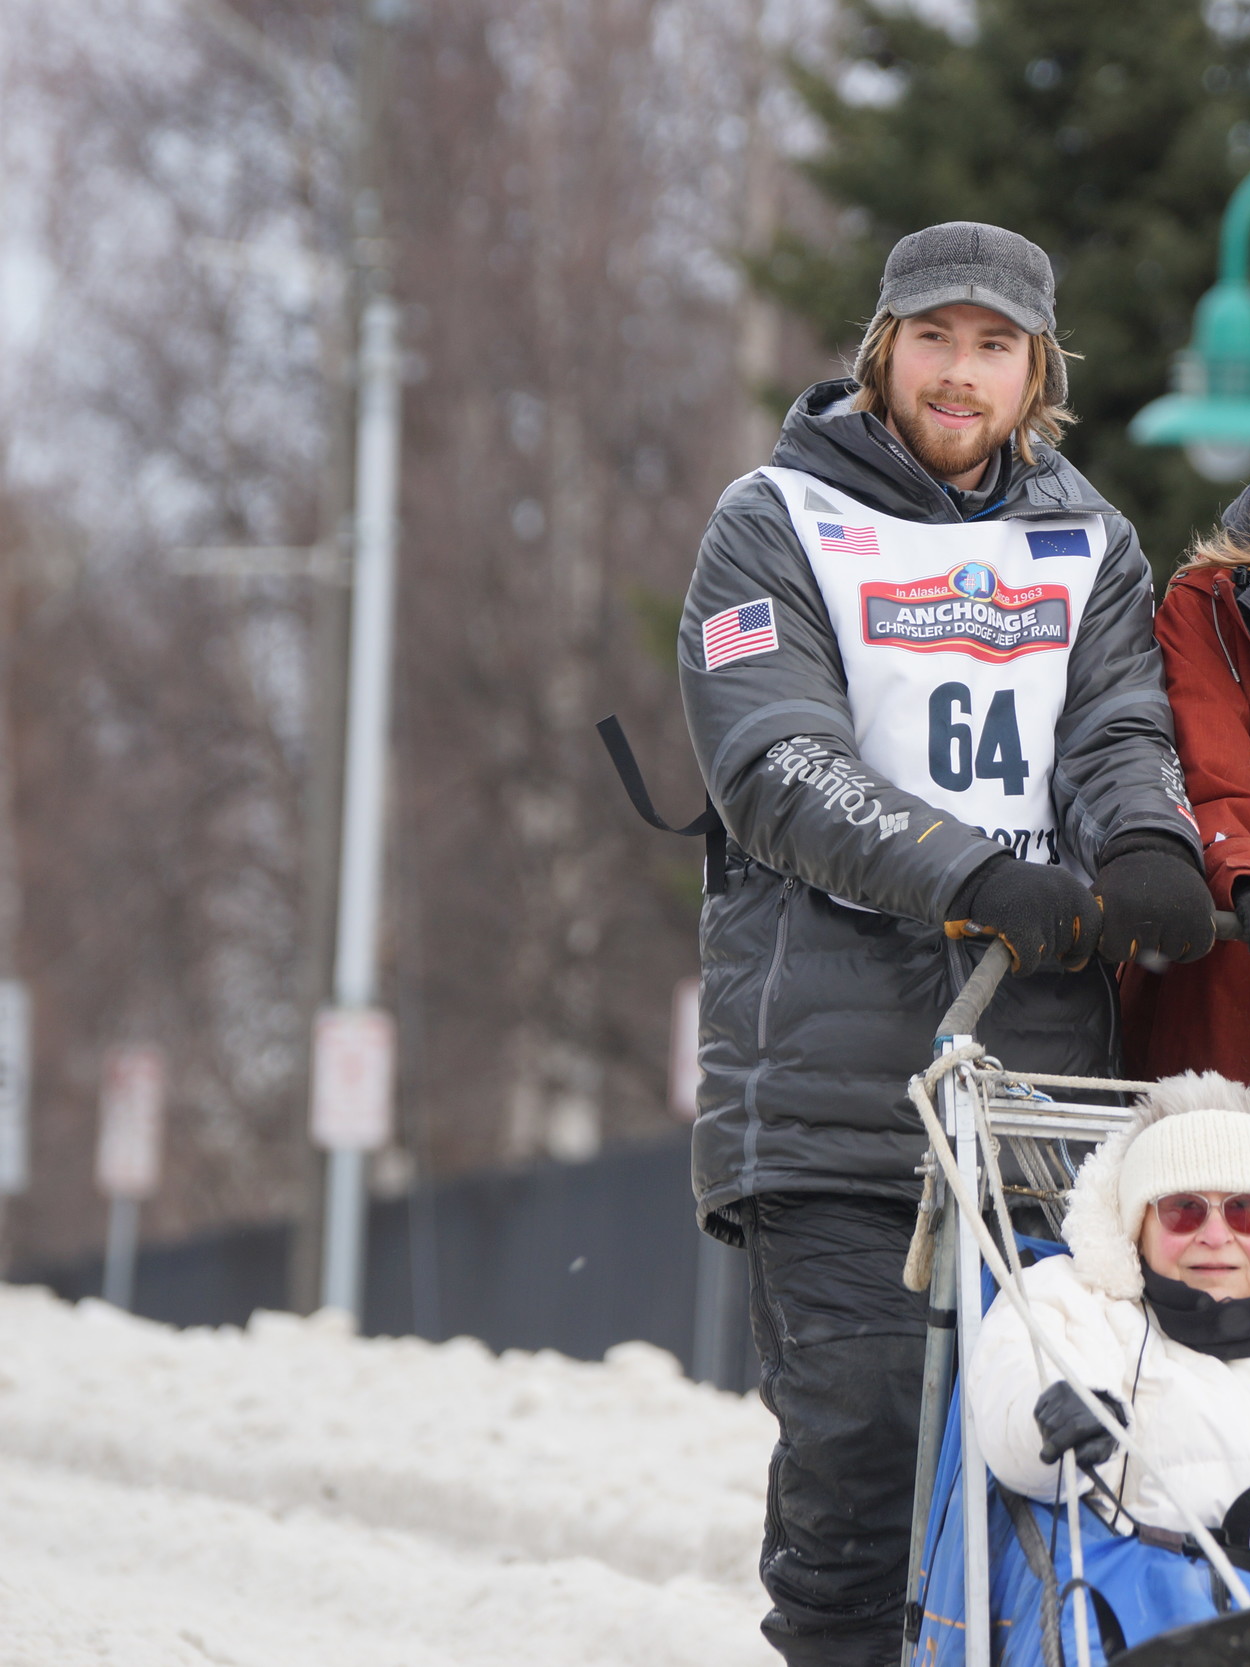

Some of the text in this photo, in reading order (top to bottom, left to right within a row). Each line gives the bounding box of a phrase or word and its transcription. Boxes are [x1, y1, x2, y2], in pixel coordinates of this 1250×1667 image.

[896, 586, 948, 598] In Alaska
[964, 569, 988, 593] #1
[1013, 587, 1043, 604] 1963
[896, 602, 1037, 632] ANCHORAGE
[876, 621, 1061, 646] CHRYSLER DODGE JEEP RAM
[929, 681, 1029, 796] 64
[766, 740, 882, 826] Columbia
